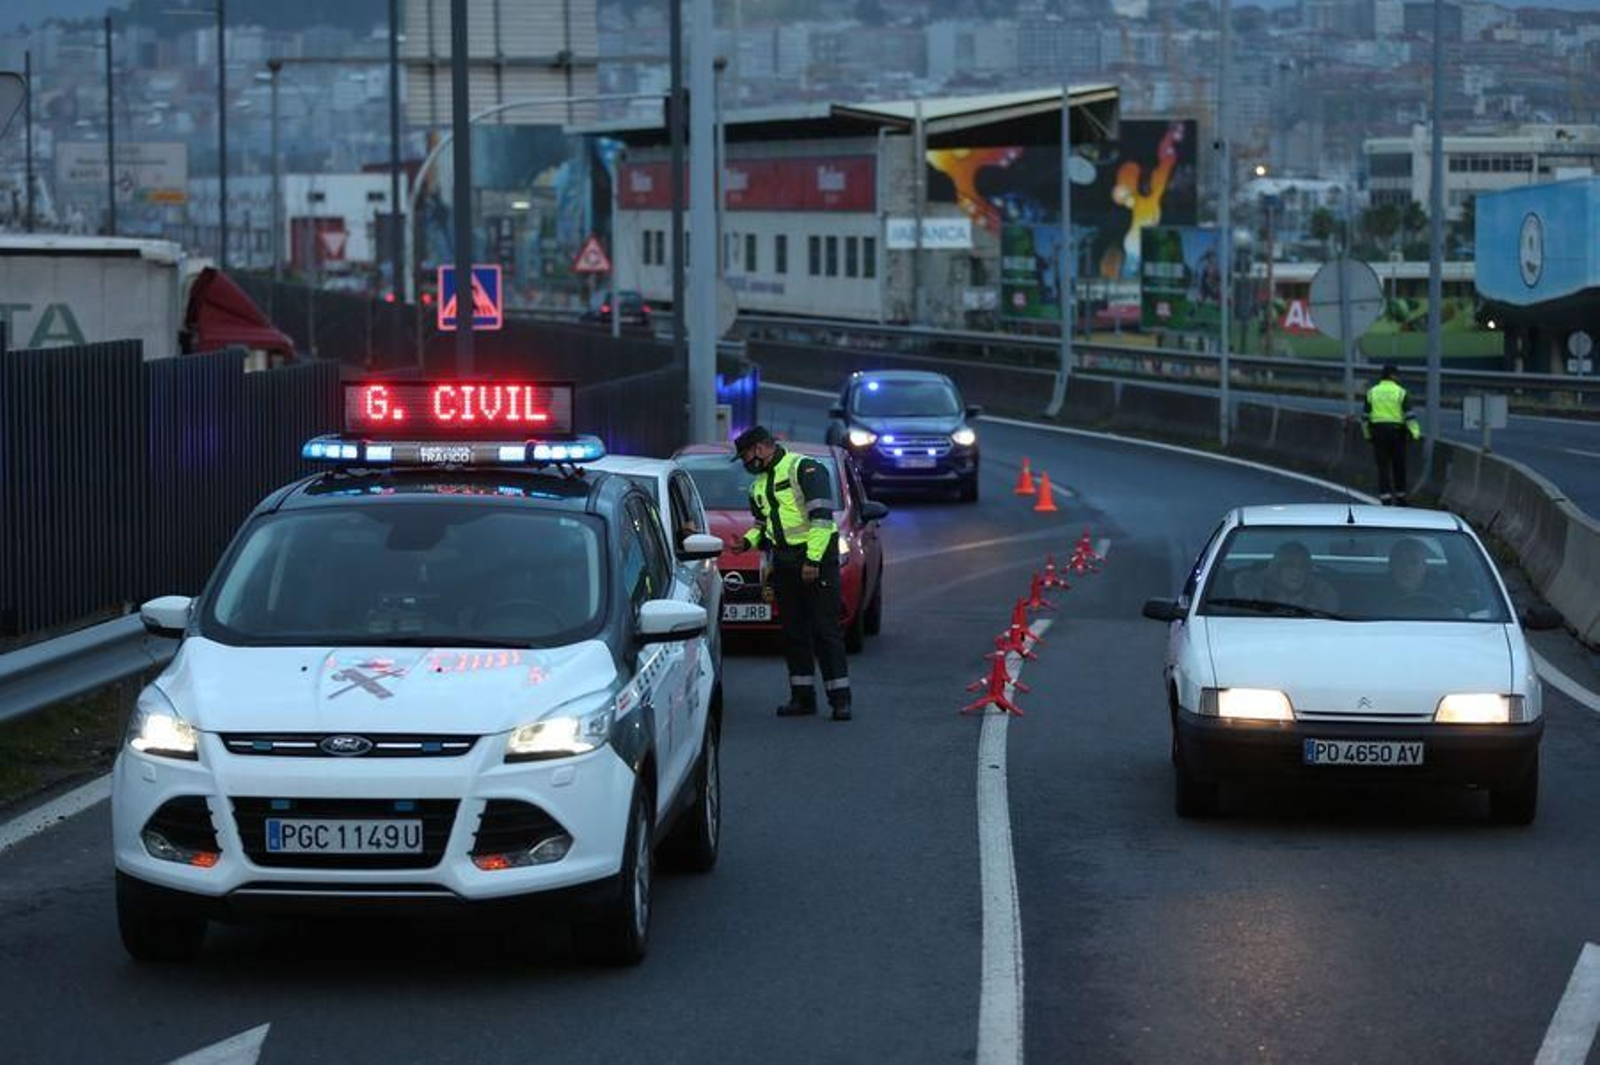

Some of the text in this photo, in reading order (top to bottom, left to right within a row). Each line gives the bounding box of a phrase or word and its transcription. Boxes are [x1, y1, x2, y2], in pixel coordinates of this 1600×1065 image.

[366, 385, 548, 421] G. CIVIL
[1343, 744, 1393, 763] 4650
[1397, 744, 1421, 763] AV
